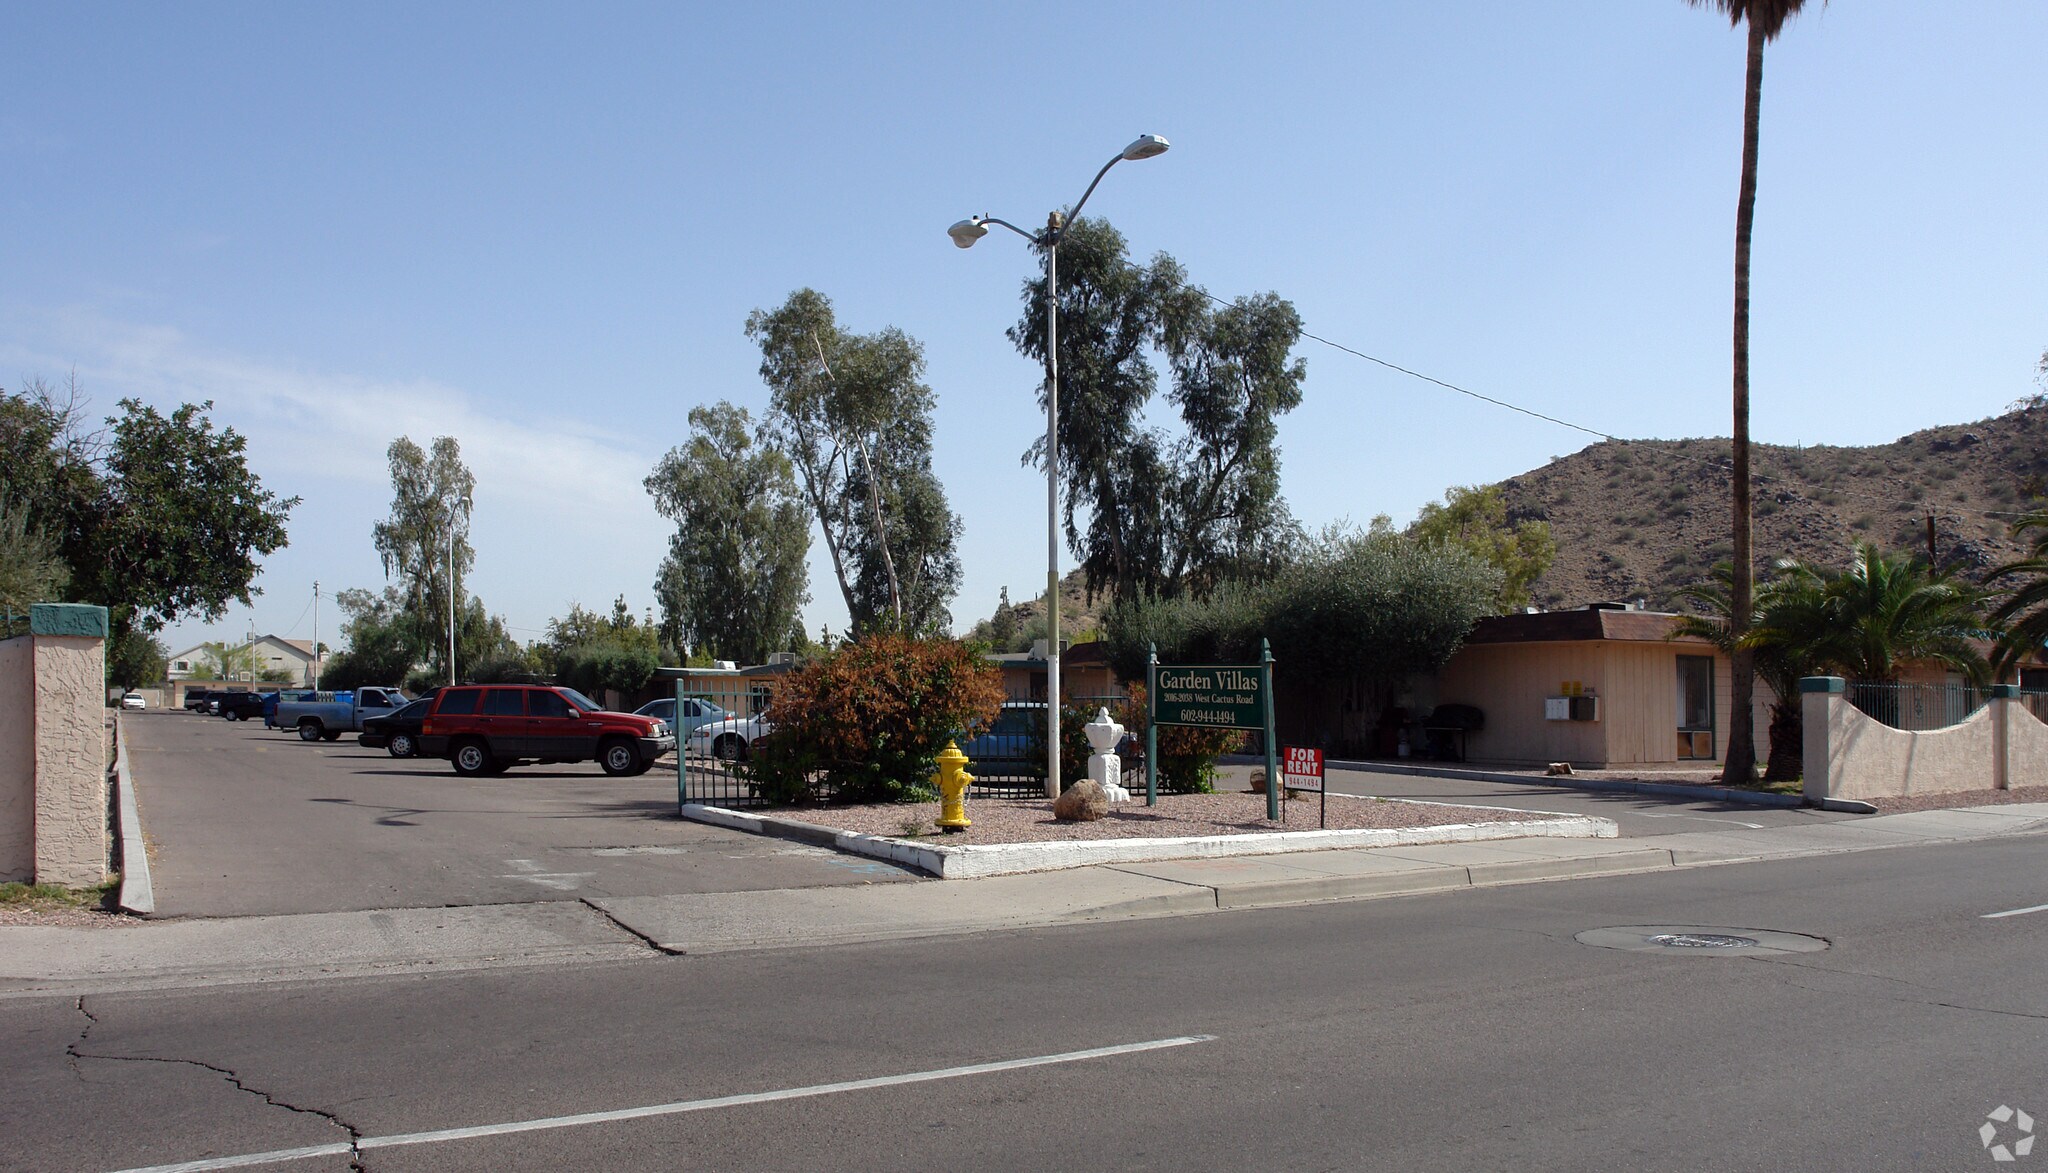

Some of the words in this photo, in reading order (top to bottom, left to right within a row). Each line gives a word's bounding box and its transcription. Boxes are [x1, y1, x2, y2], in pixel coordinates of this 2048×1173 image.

[1159, 670, 1211, 689] Garden
[1215, 670, 1258, 691] Villas
[1195, 693, 1210, 703] West
[1211, 694, 1234, 704] Cactus
[1236, 694, 1254, 705] Road
[1180, 709, 1236, 724] 602-944-1494
[1291, 747, 1315, 761] FOR
[1287, 760, 1318, 775] RENT
